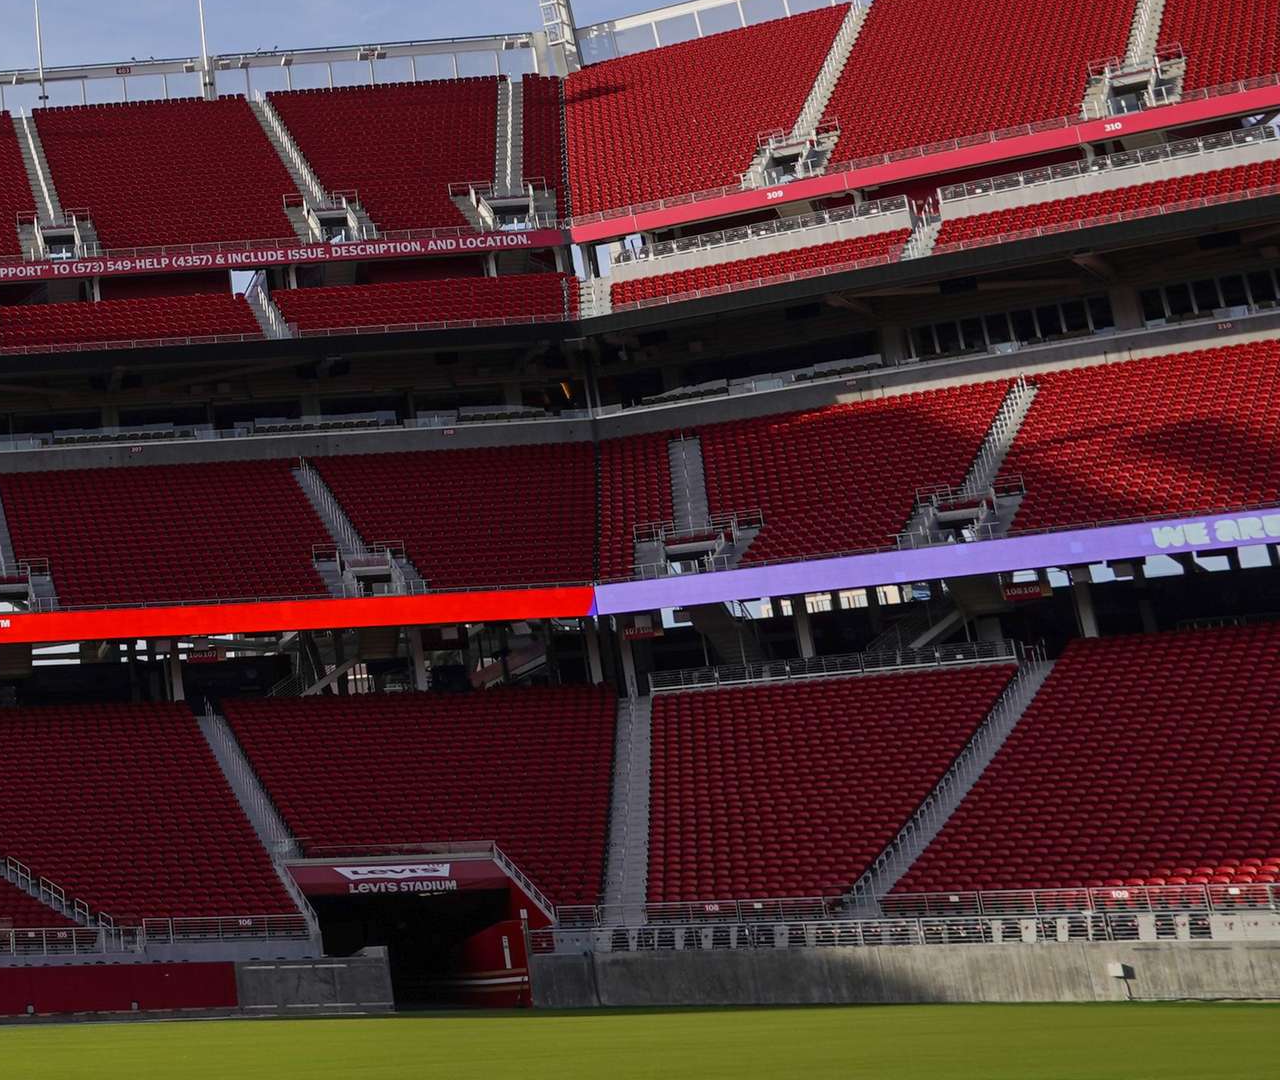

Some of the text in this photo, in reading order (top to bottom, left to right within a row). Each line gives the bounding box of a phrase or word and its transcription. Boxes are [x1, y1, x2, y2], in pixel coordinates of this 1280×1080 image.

[1104, 121, 1121, 130] 310
[766, 190, 783, 199] 309
[51, 264, 69, 275] TO
[73, 261, 104, 274] (573)
[107, 258, 169, 271] 549-HELP
[172, 255, 213, 268] (4357)
[215, 253, 225, 264] &
[228, 250, 284, 263] INCLUDE
[288, 247, 329, 260] ISSUE,
[331, 241, 425, 256] DESCRIPTION,
[427, 238, 457, 251] AND
[459, 234, 532, 248] LOCATION.
[1151, 521, 1211, 549] WE
[400, 880, 457, 892] STADIUM
[1111, 890, 1129, 898] 109
